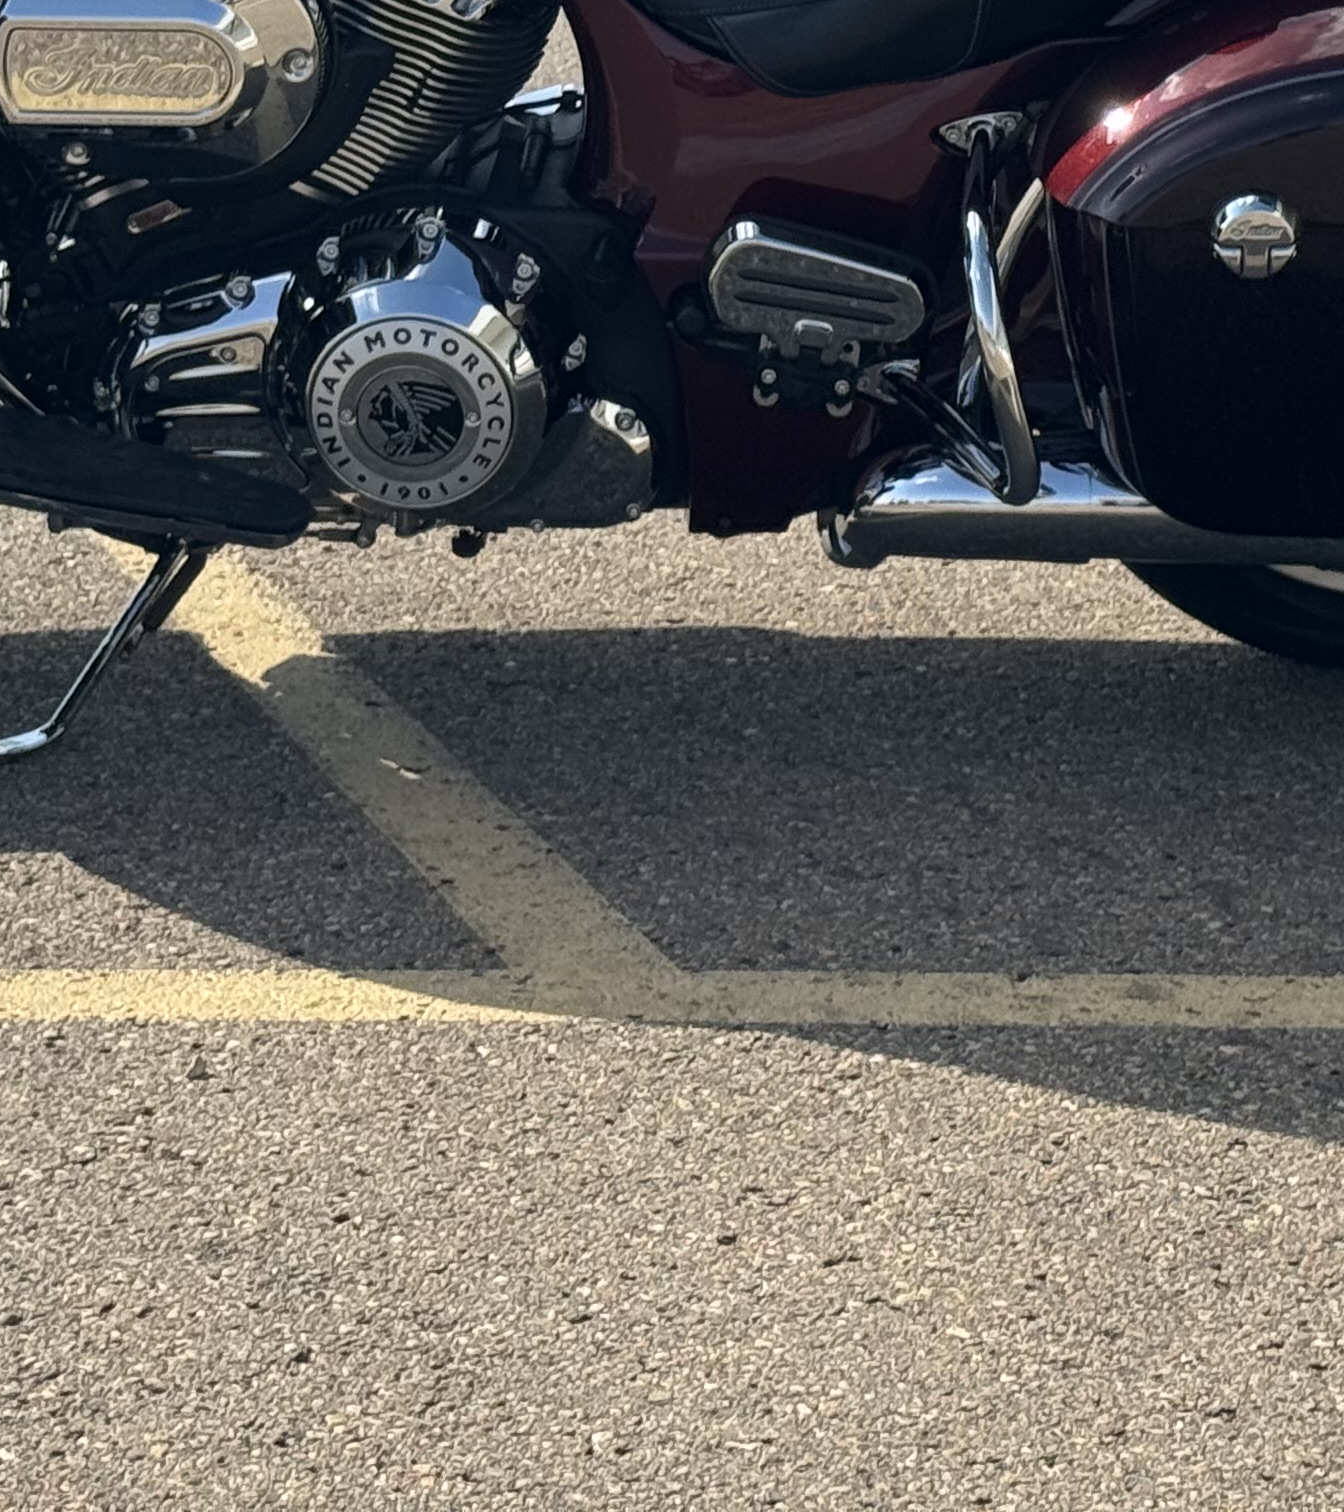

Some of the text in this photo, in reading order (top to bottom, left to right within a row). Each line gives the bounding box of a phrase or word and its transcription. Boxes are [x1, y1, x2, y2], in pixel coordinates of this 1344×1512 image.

[23, 40, 216, 97] Indian
[316, 327, 505, 470] INDIAN MOTORCYCLE
